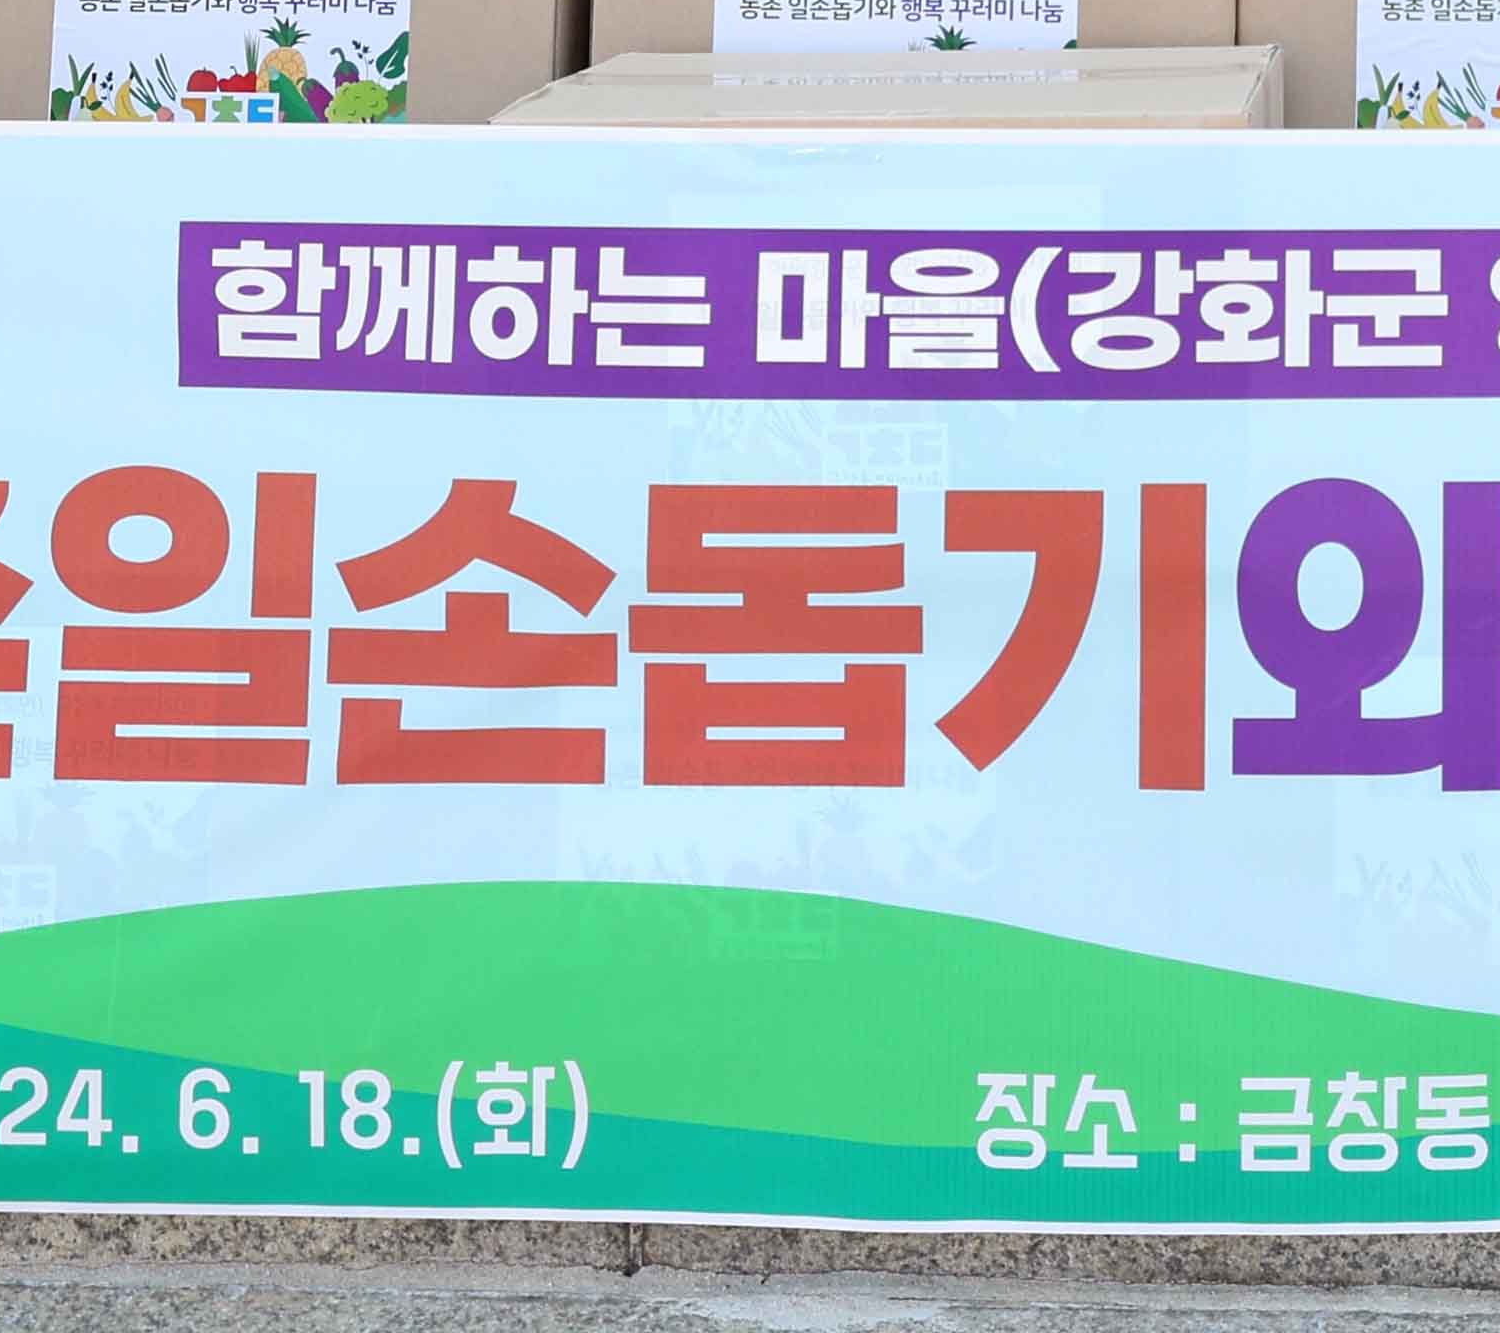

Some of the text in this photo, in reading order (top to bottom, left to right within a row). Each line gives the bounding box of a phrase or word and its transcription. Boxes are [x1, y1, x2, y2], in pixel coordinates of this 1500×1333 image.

[1020, 0, 1063, 23] 나눔
[212, 241, 710, 366] 함께하는
[757, 248, 1447, 371] 마을(강화군
[978, 1074, 1136, 1168] 장소
[1240, 1073, 1489, 1170] 금창동
